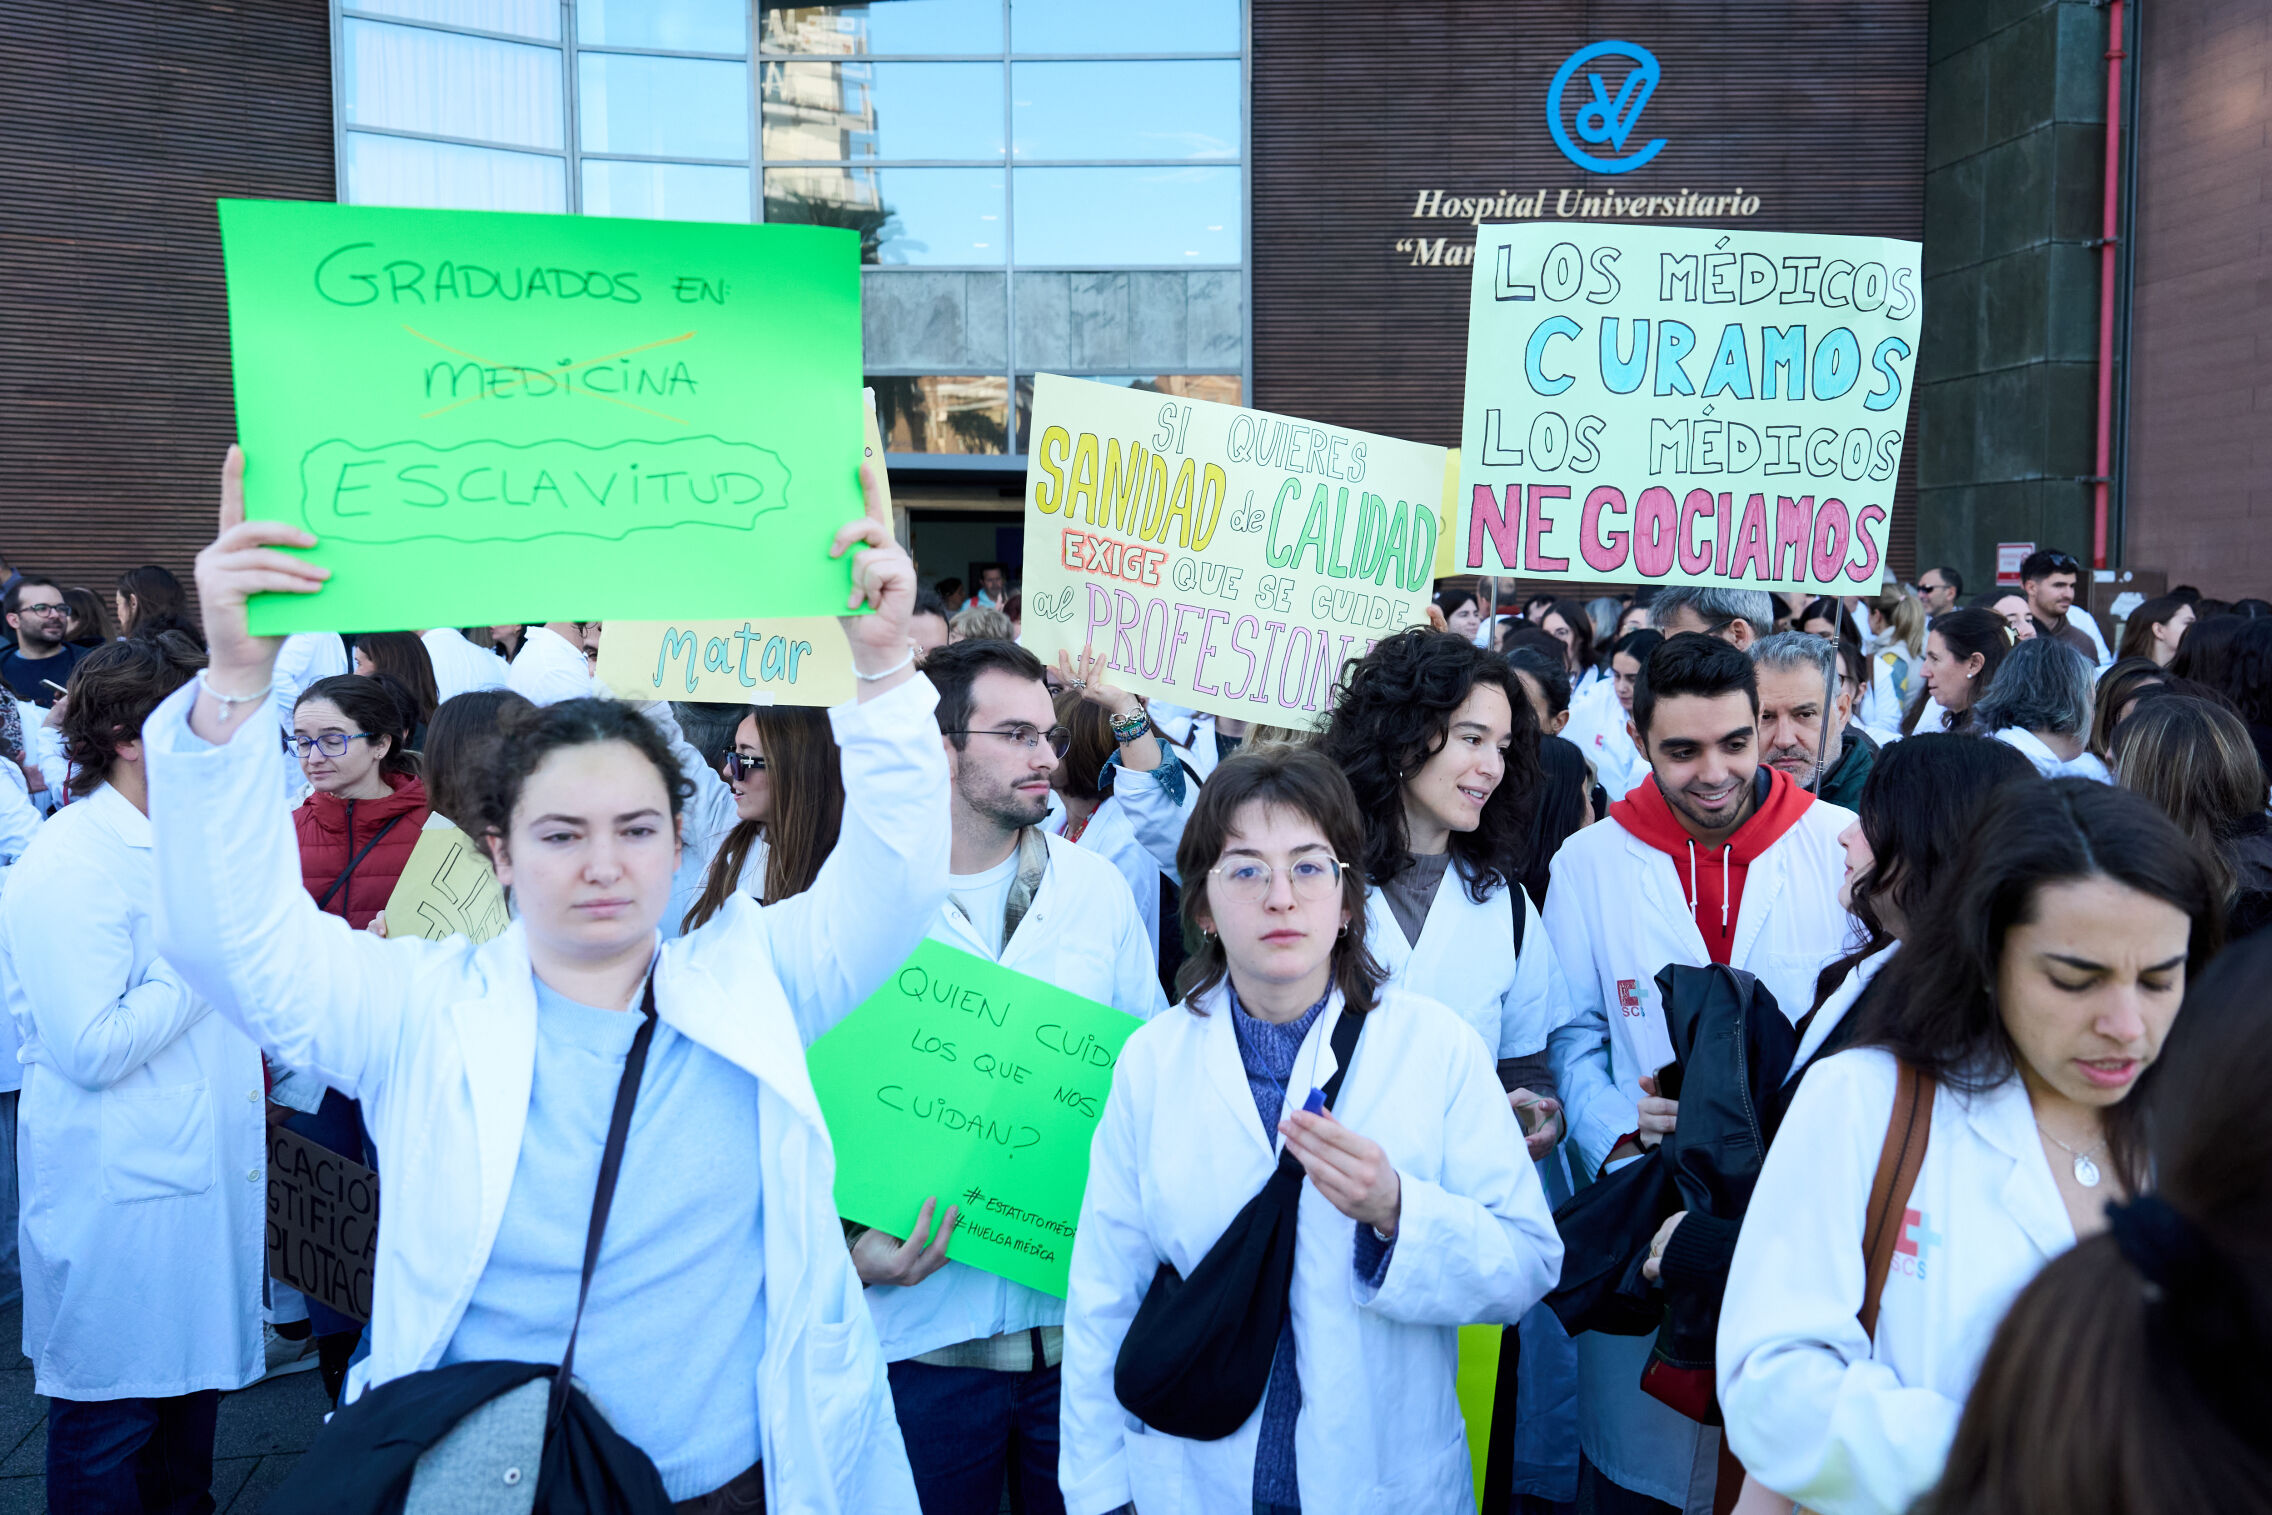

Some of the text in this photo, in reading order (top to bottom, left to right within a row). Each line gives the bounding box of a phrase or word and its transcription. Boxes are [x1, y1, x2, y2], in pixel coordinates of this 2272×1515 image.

[1411, 188, 1760, 225] Hospital Universitario
[314, 242, 642, 306] GRADUADOS
[1495, 236, 1916, 320] LOS MÉDICOS
[1524, 315, 1911, 411] CURAMOS
[1152, 402, 1367, 483] SI QUIERES
[1482, 404, 1902, 482] LOS MÉDICOS
[1035, 426, 1437, 592] SANIDAD de CALIDAD
[1466, 483, 1887, 583] NEGOCIAMOS
[1064, 534, 1165, 586] EXIGE
[1172, 557, 1244, 600] QUE
[1255, 575, 1295, 612] SE
[653, 622, 812, 693] Matar
[1033, 582, 1379, 713] al PROFESION
[899, 966, 1011, 1027] QUIEN
[911, 1028, 1098, 1118] LOS QUE NOS
